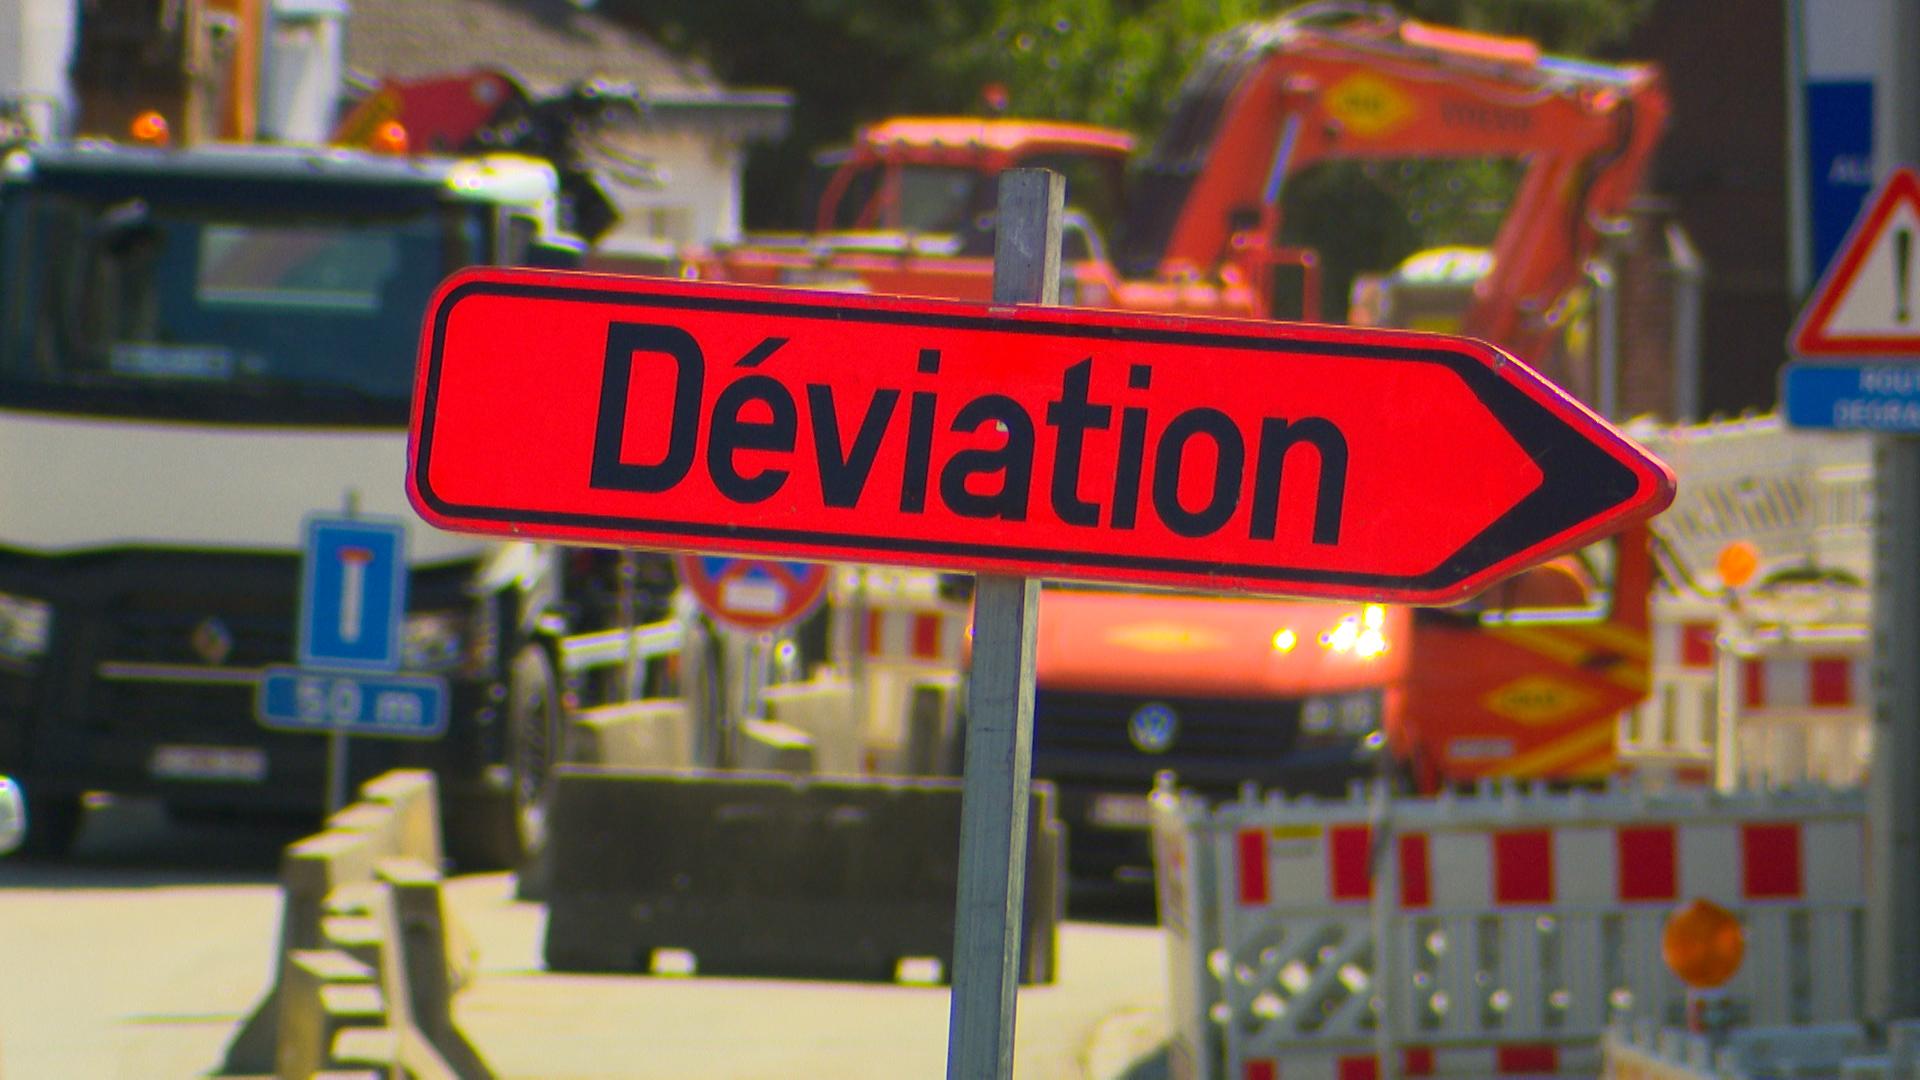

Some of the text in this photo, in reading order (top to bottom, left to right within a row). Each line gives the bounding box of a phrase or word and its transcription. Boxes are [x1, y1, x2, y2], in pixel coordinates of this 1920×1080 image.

[590, 321, 1348, 546] Déviation
[298, 676, 423, 726] 50 m
